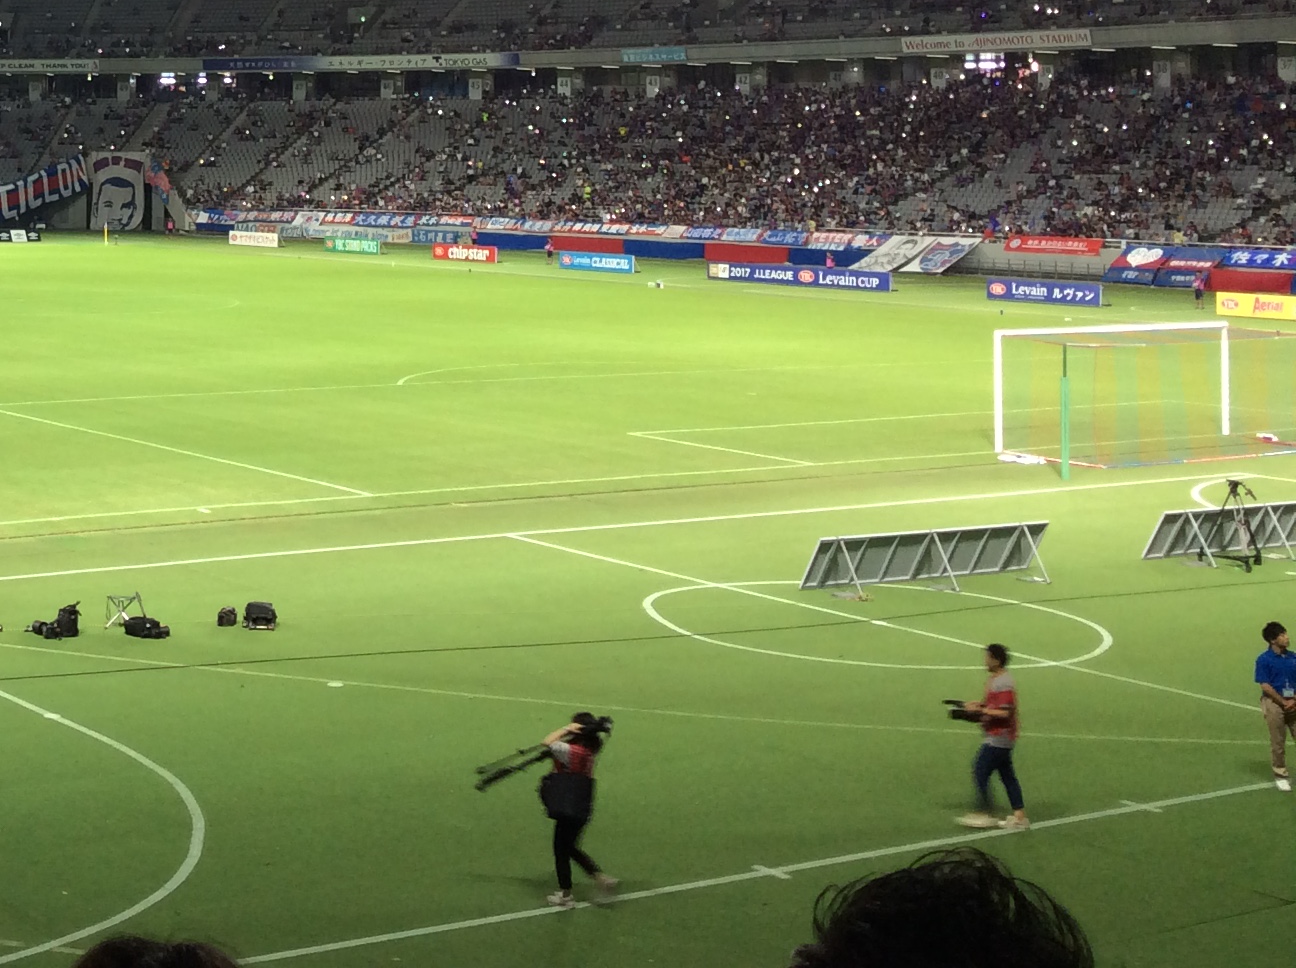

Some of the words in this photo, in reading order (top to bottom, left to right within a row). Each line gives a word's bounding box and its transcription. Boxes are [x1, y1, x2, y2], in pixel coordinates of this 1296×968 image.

[904, 39, 951, 50] Welcome
[954, 38, 965, 49] to
[968, 34, 1034, 48] AJINOMOTO
[1039, 32, 1089, 44] STADIUM
[444, 57, 470, 66] TOKYO
[471, 56, 488, 66] GAS
[1230, 251, 1292, 267] 佐々木
[730, 267, 751, 278] 2017
[753, 268, 794, 281] J.LEAGUE
[818, 271, 857, 287] Levain
[858, 277, 880, 288] CUP
[1011, 282, 1047, 296] Levain
[1052, 287, 1095, 301] ルヴァン
[1253, 296, 1284, 314] Aerial
